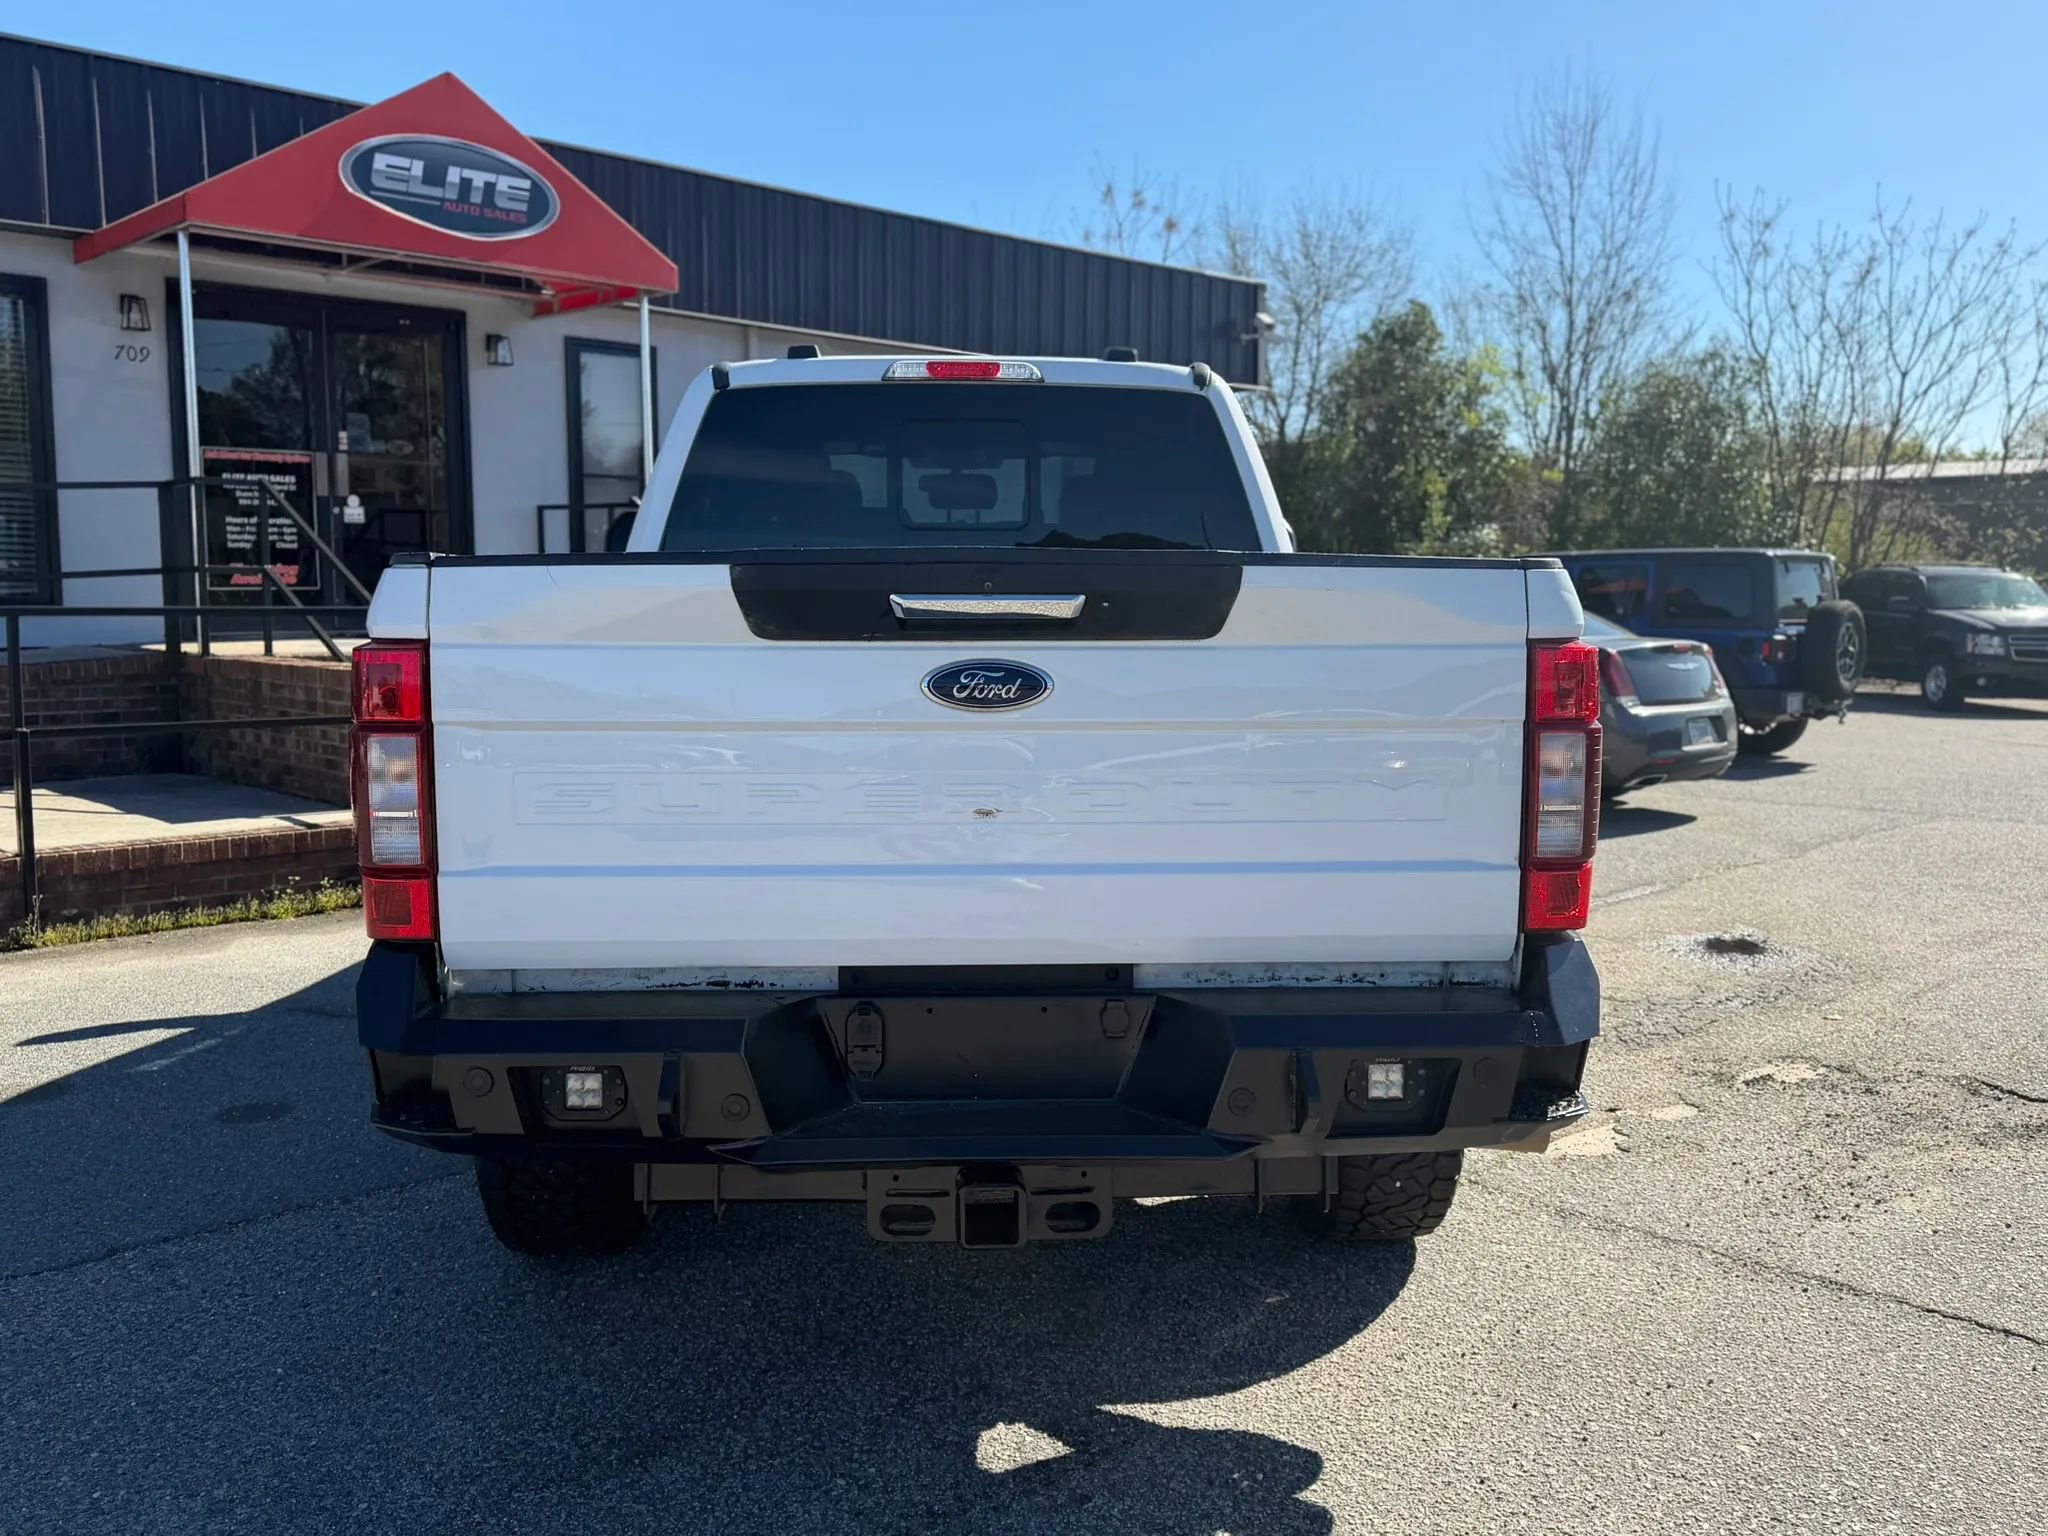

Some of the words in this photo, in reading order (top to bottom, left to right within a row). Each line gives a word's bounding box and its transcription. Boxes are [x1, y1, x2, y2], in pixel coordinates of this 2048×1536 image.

[370, 151, 533, 212] ELITE
[442, 201, 482, 217] AUTO
[483, 206, 528, 224] SALES
[114, 344, 151, 364] 709
[269, 474, 297, 484] SALES
[225, 515, 248, 524] Hours
[952, 669, 1023, 700] Ford
